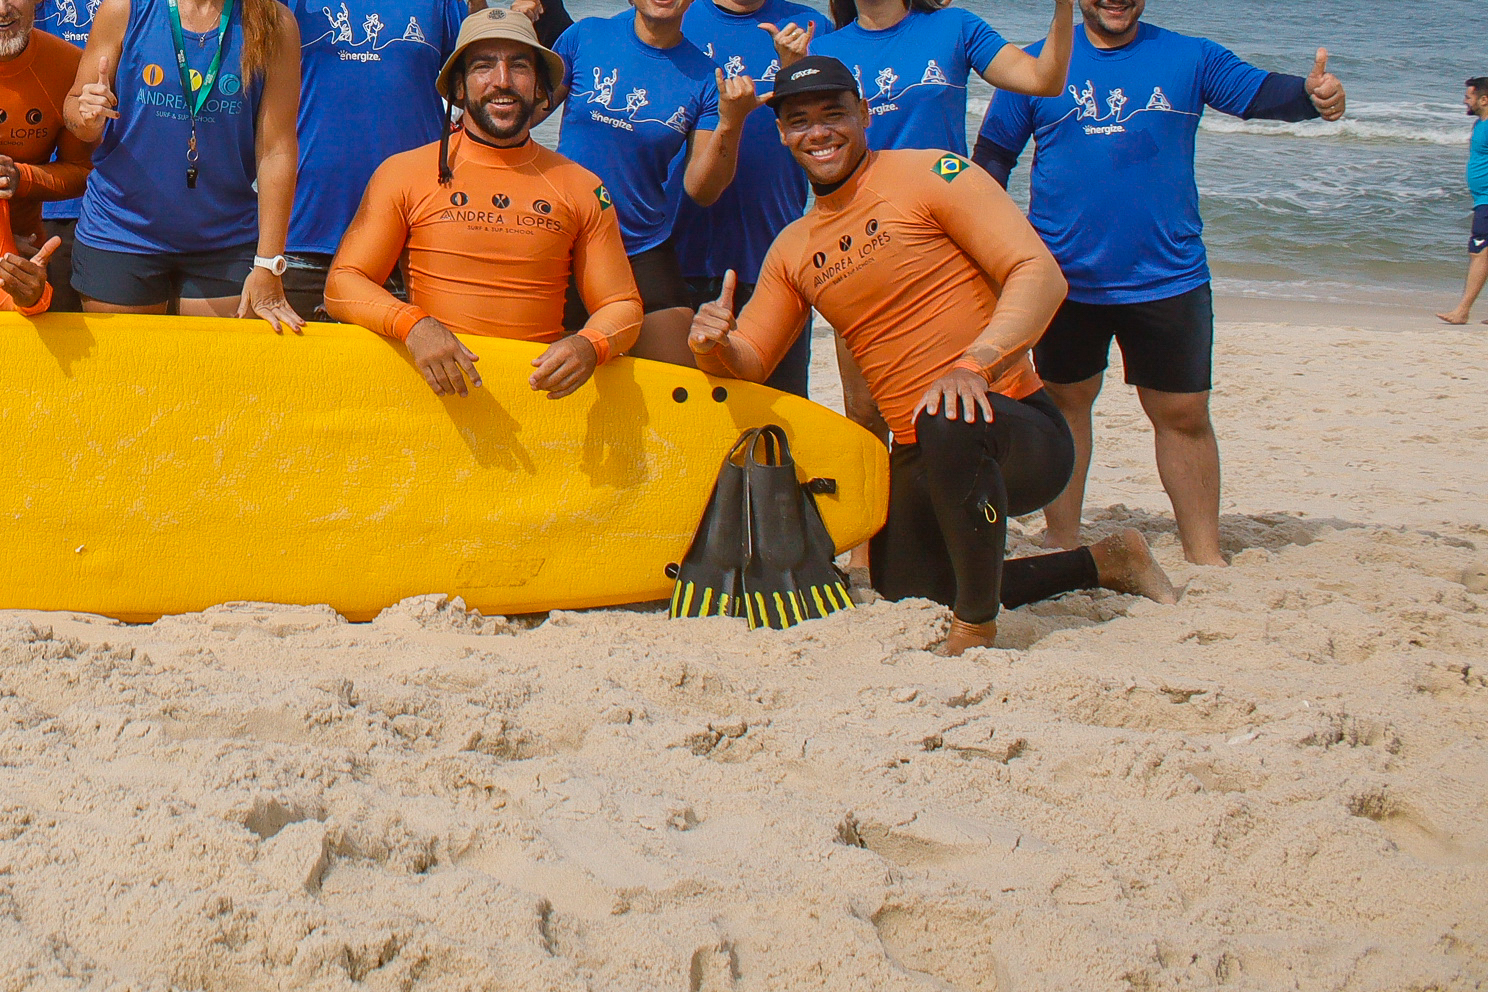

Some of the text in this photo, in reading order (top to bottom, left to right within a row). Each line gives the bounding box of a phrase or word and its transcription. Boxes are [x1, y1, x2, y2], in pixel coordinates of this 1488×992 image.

[337, 50, 381, 63] energize.
[155, 110, 171, 118] SURF
[177, 113, 190, 121] SUP
[590, 110, 634, 131] energize.
[10, 128, 49, 139] LOPES
[1083, 124, 1126, 135] energize.
[440, 210, 562, 231] ANDREA LOPES
[813, 231, 891, 288] ANDREA LOPES
